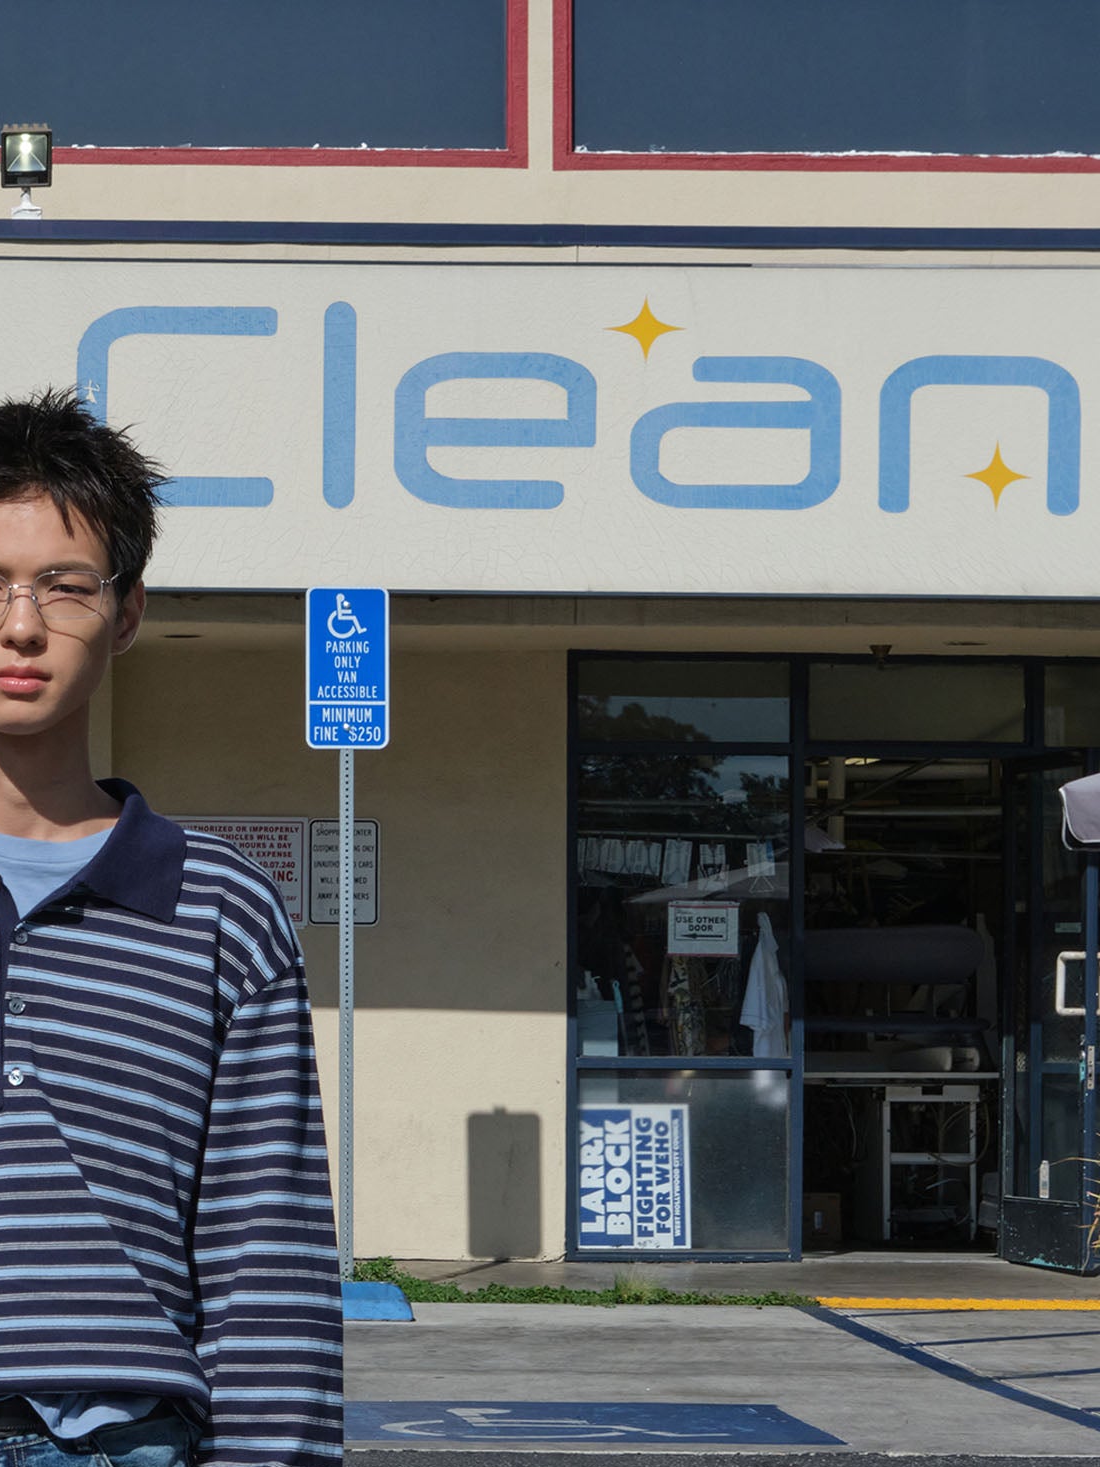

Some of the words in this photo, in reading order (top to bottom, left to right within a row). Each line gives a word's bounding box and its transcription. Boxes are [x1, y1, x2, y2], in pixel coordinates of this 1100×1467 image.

[77, 300, 1081, 516] Clean
[325, 640, 370, 654] PARKING
[333, 655, 361, 669] ONLY
[336, 670, 358, 683] VAN
[316, 685, 378, 699] ACCESSIBLE
[321, 707, 373, 723] MINIMUM
[313, 726, 340, 742] FINE
[347, 725, 382, 743] $250
[249, 825, 300, 833] IMPROPERLY
[272, 870, 298, 882] INC.
[696, 916, 726, 924] OTHER
[688, 924, 714, 932] DOOR
[654, 1120, 671, 1187] WEHO
[580, 1120, 606, 1233] LARRY
[604, 1119, 632, 1236] BLOCK
[635, 1116, 654, 1238] FIGHTING
[655, 1191, 671, 1235] FOR
